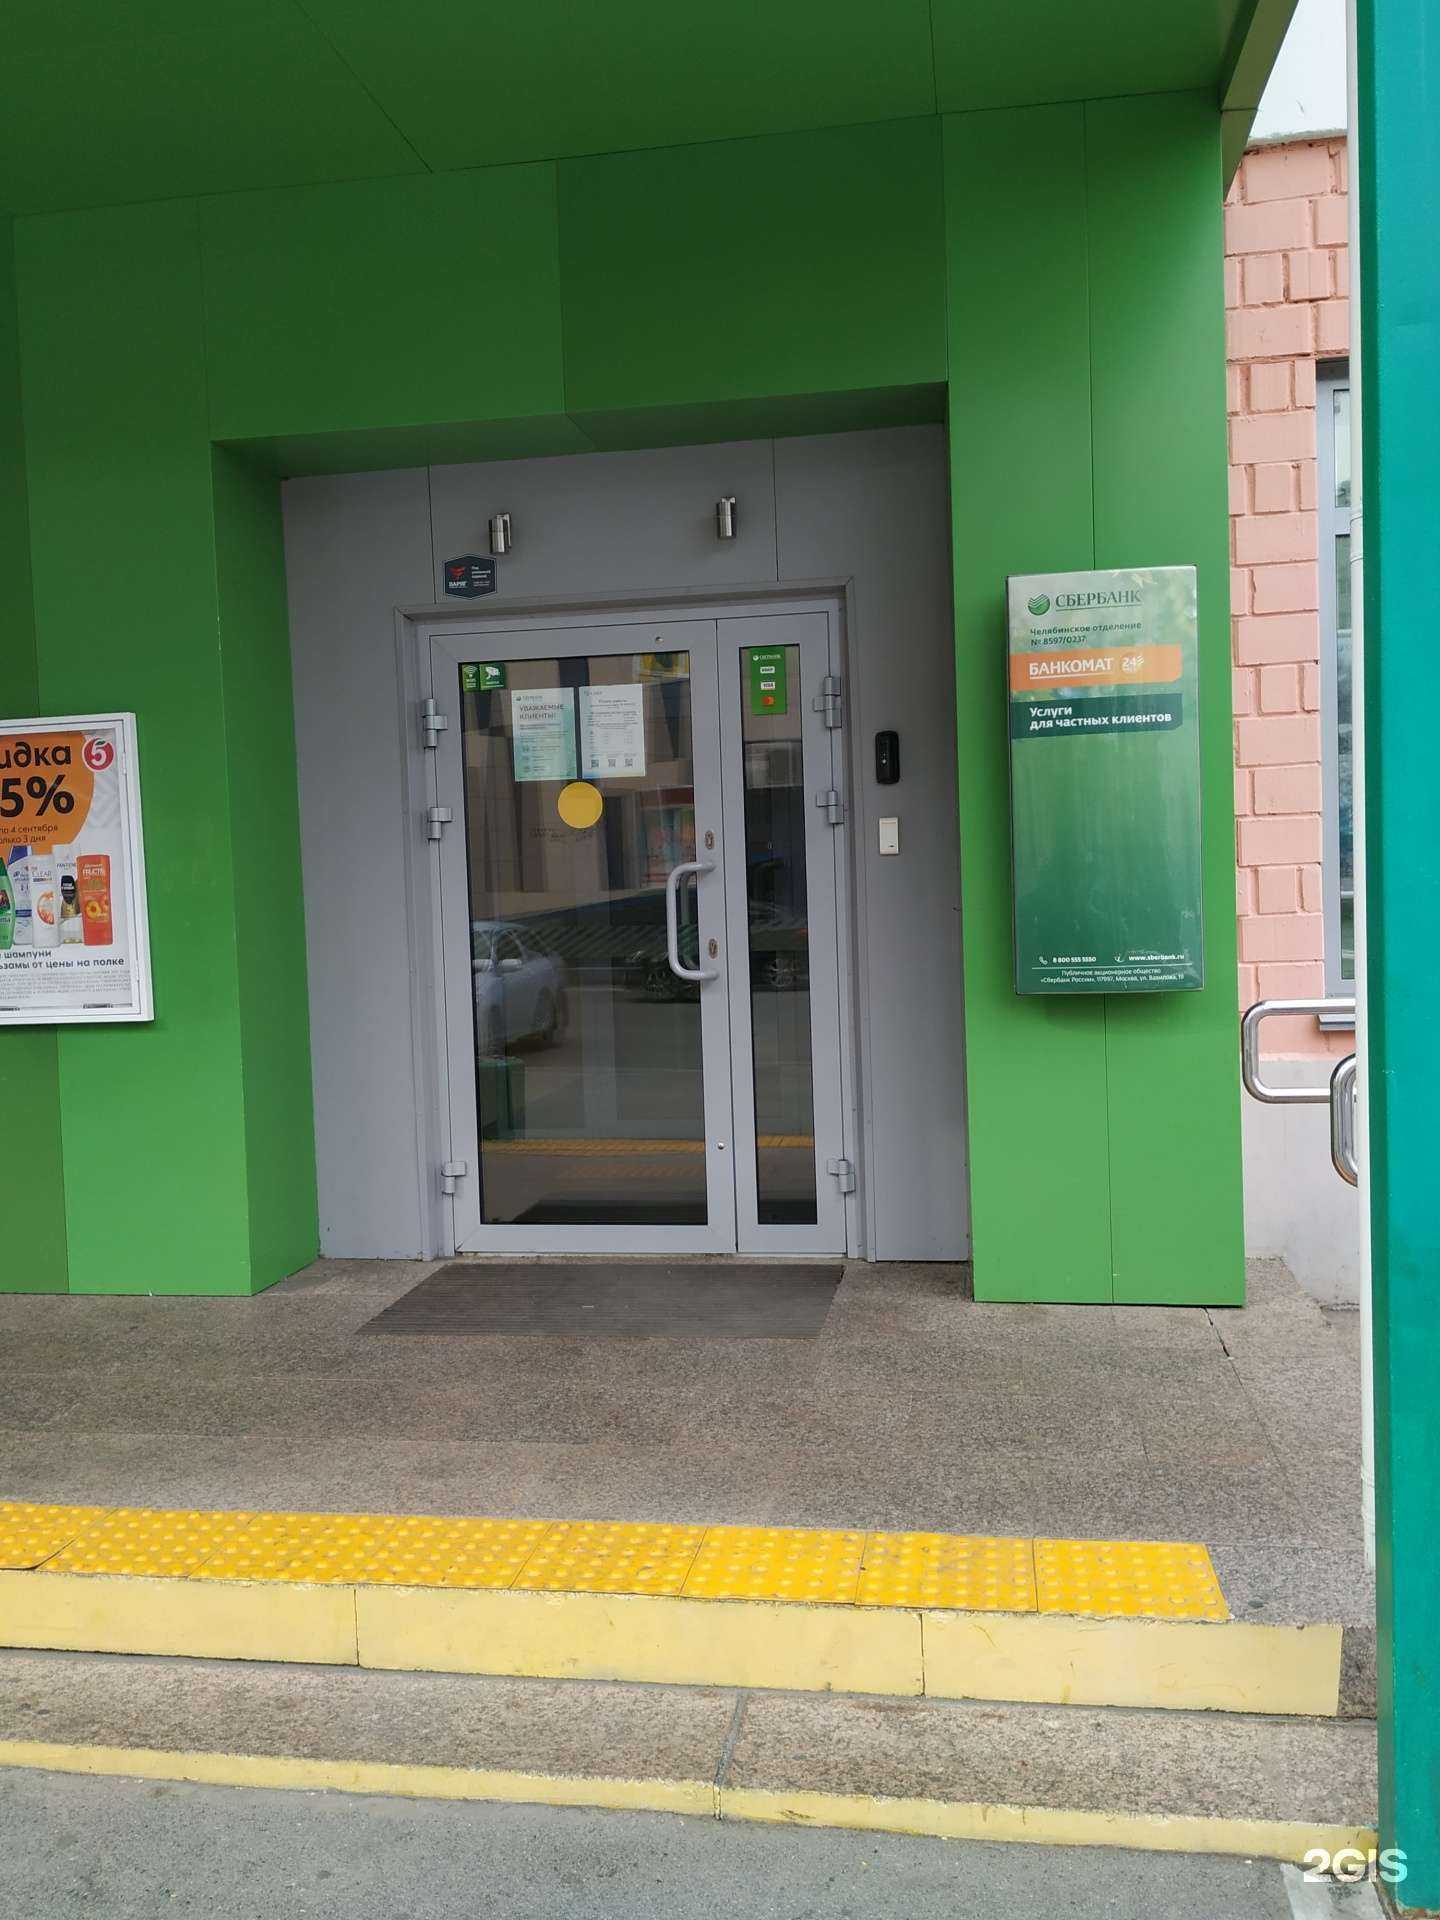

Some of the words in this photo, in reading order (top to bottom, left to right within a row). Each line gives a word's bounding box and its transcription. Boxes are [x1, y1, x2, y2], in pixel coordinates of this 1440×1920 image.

[1055, 590, 1141, 609] СБЕРБАНК
[1030, 625, 1091, 636] Челябинское
[1092, 622, 1142, 632] отделение
[1043, 636, 1086, 645] 8597/0237
[1029, 657, 1115, 677] БАНКОМАТ
[1029, 706, 1072, 718] Услуги
[1029, 719, 1054, 731] для
[1055, 716, 1109, 728] частных
[1112, 713, 1172, 725] клиентов
[18, 823, 58, 834] сентября
[4, 950, 52, 960] шампуни
[32, 961, 43, 969] от
[46, 959, 74, 969] цены
[77, 958, 91, 967] на
[93, 957, 125, 967] полке
